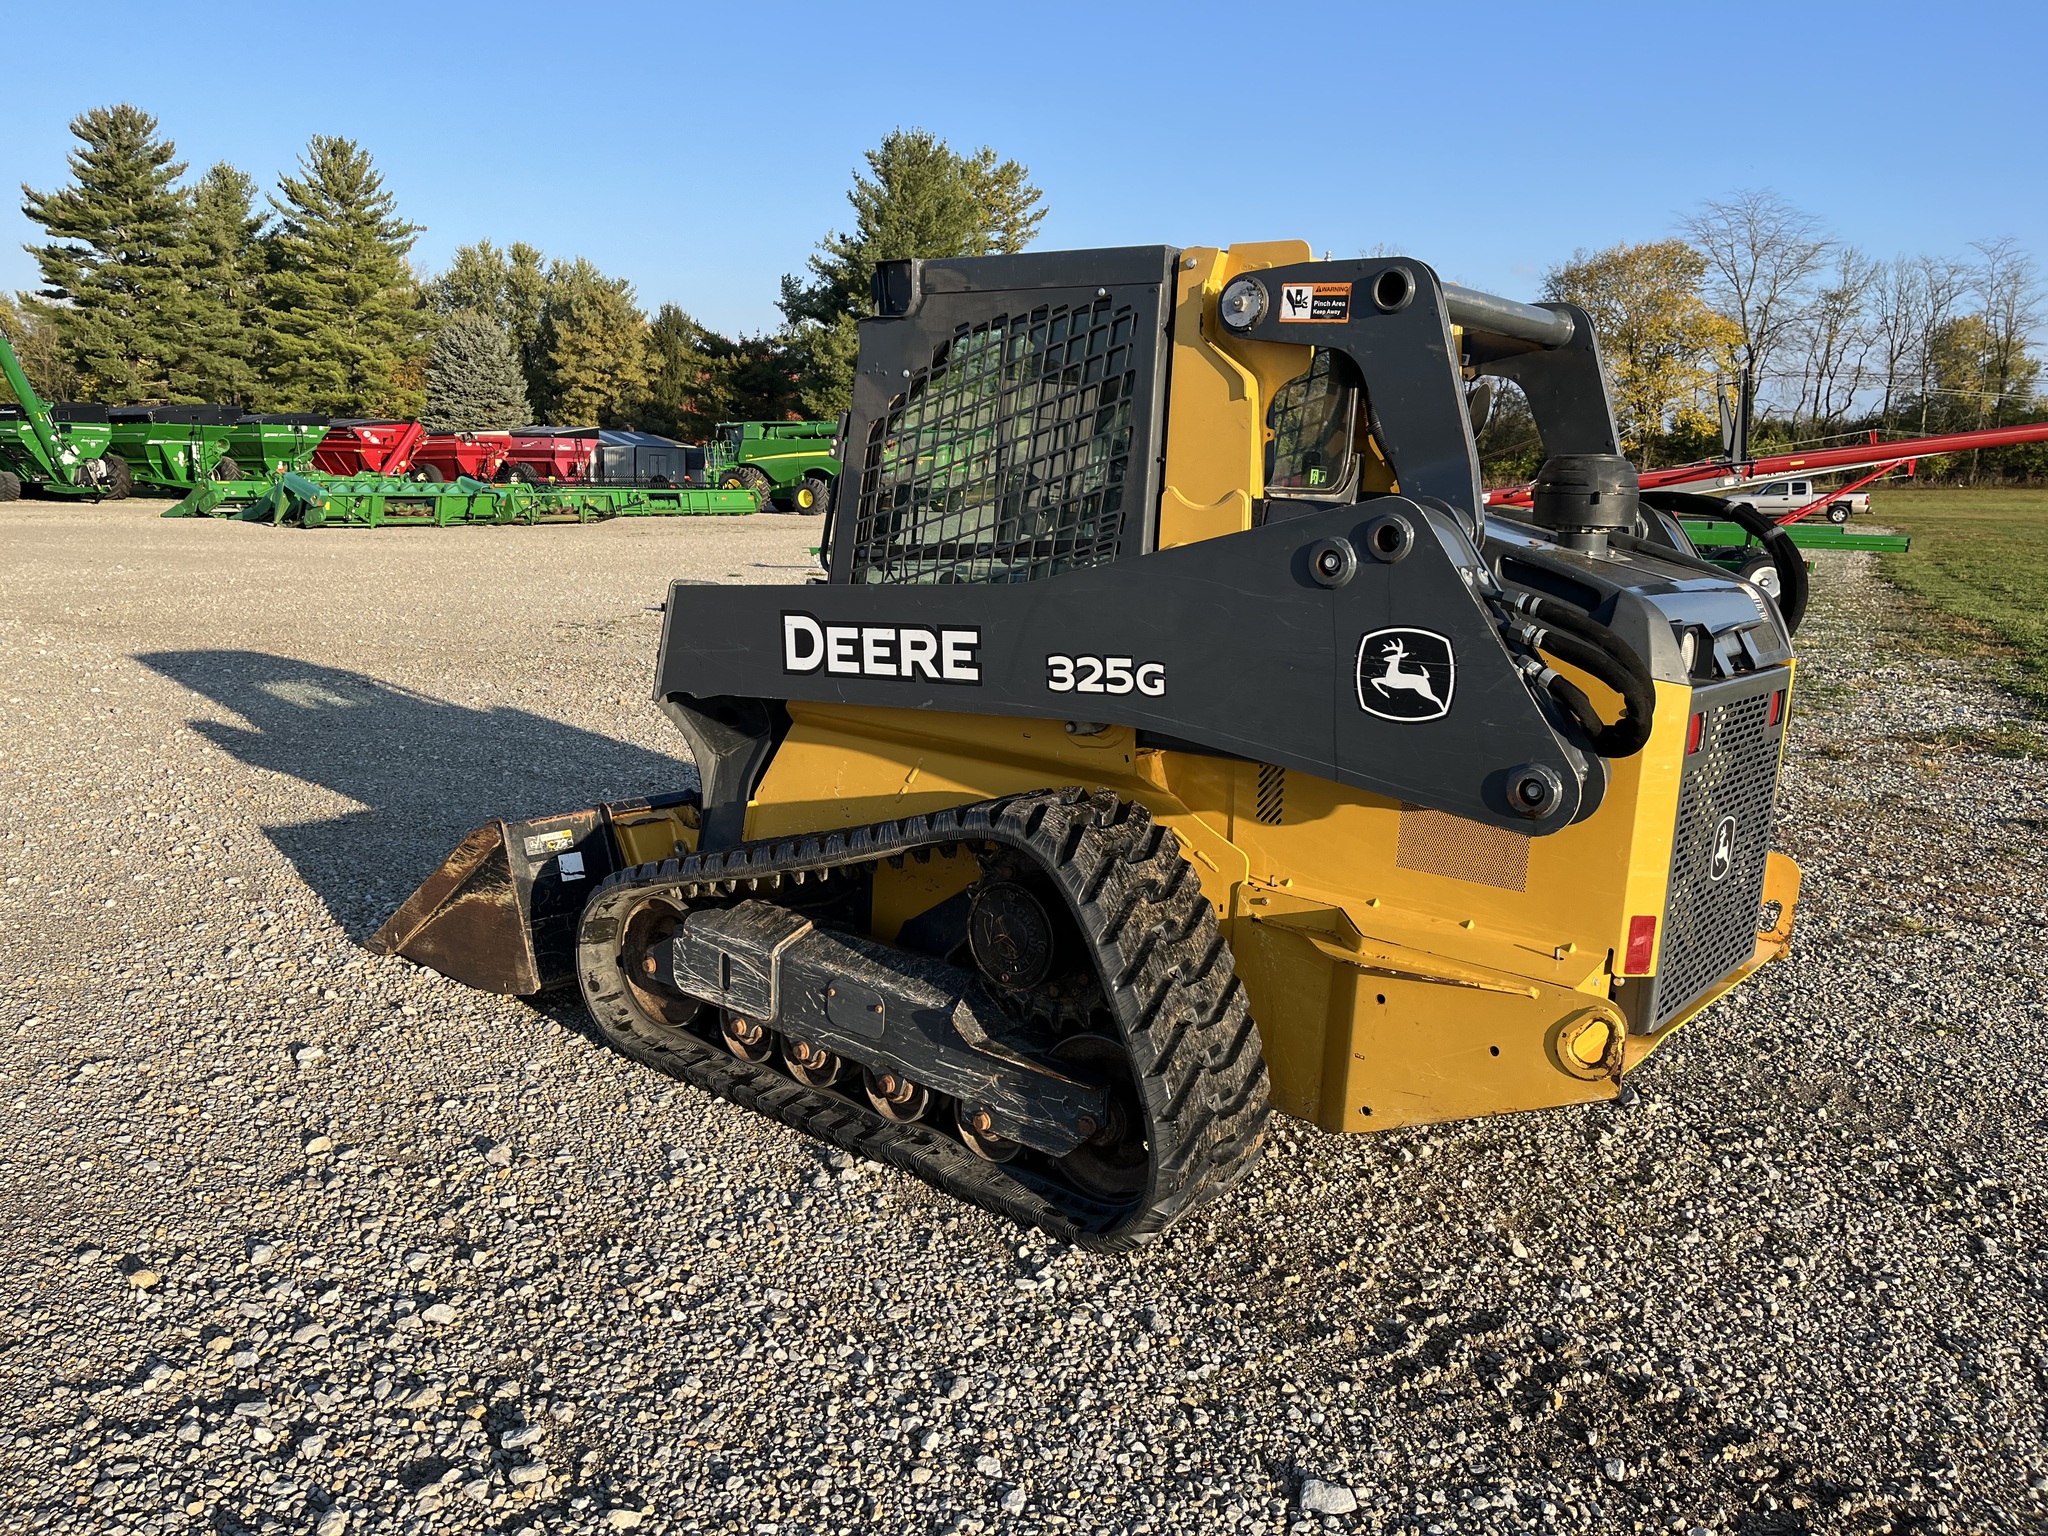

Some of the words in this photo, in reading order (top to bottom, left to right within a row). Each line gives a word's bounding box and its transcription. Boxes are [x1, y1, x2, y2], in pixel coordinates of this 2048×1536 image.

[1312, 308, 1326, 316] Keep
[1326, 308, 1341, 316] Away
[784, 615, 979, 681] DEERE
[1048, 655, 1166, 697] 325G
